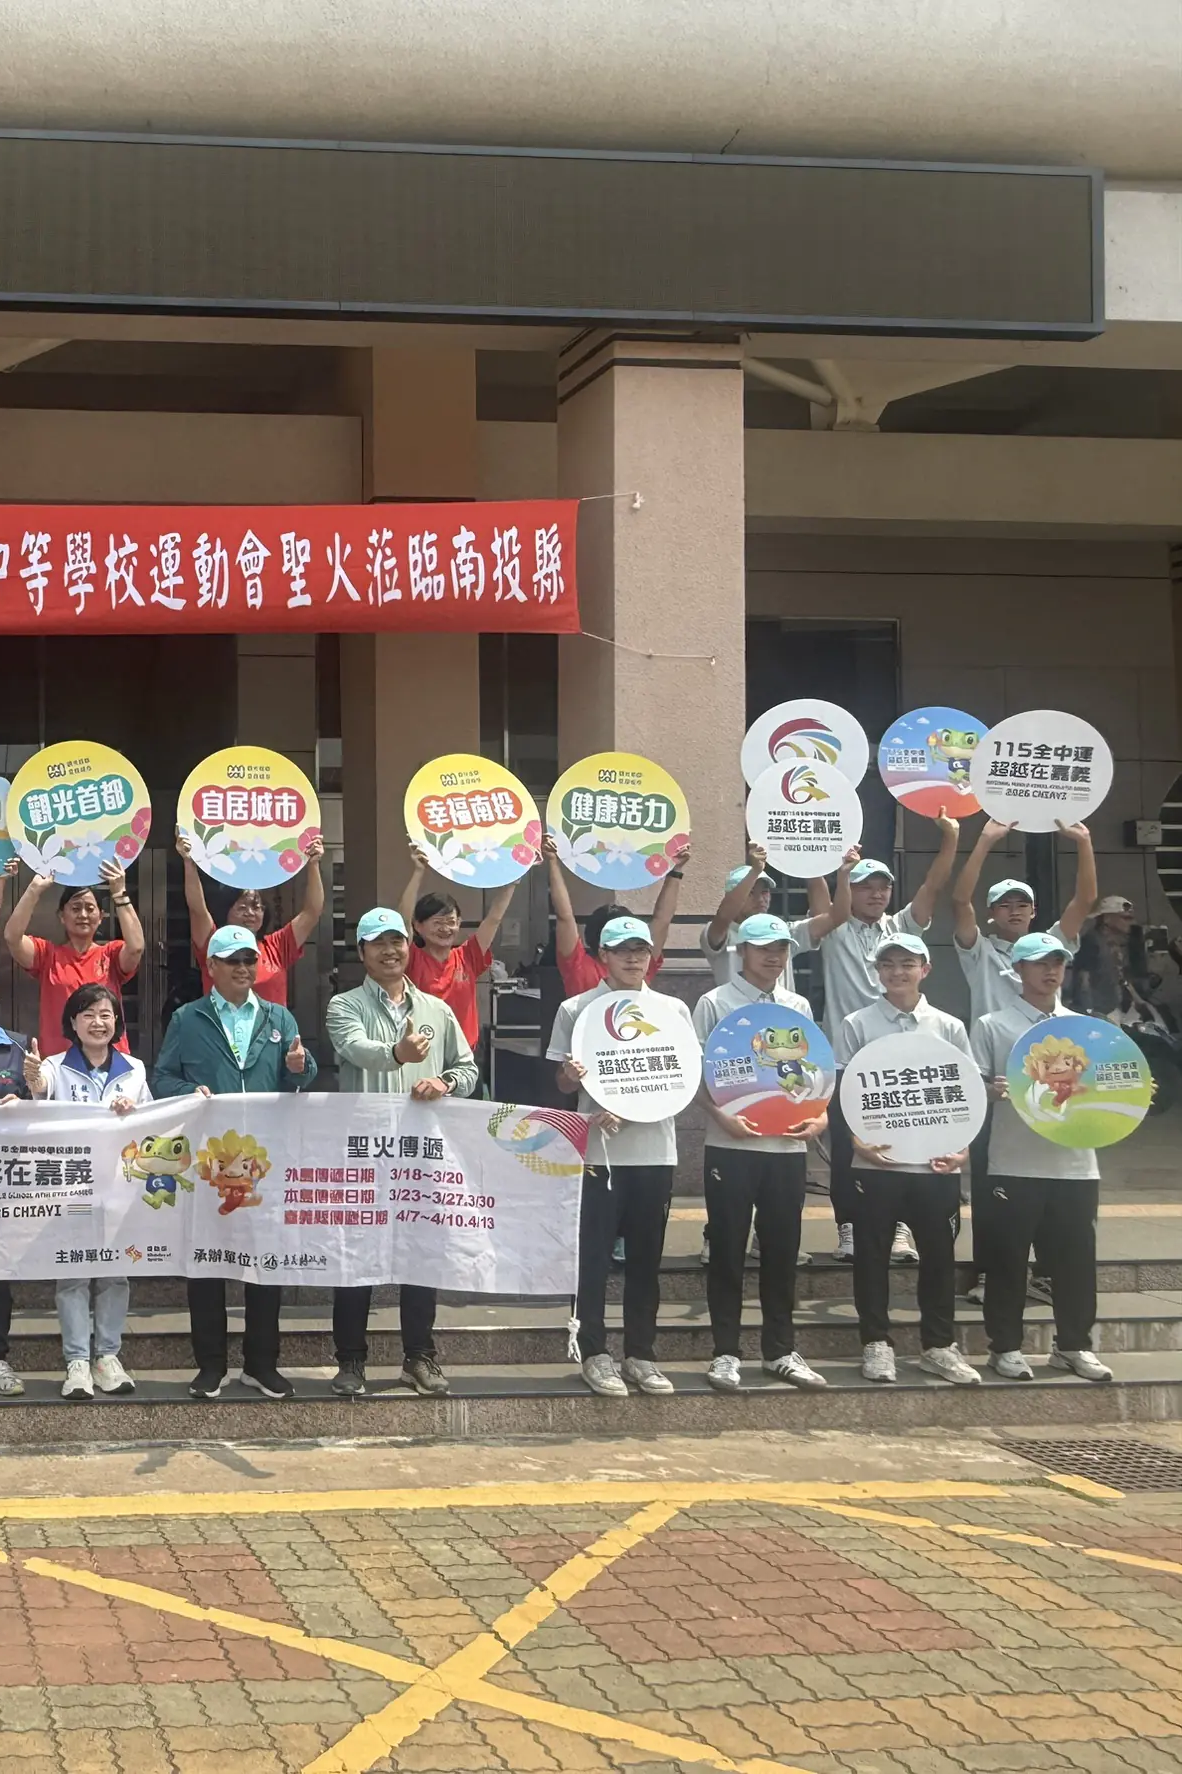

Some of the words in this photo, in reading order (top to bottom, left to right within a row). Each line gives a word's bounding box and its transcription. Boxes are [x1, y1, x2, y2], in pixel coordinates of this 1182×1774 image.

[994, 741, 1094, 763] 115全中運
[26, 778, 125, 827] 觀光首都
[201, 789, 298, 822] 宜居城市
[424, 791, 518, 828] 幸福南投
[570, 791, 668, 829] 健康活力
[857, 1063, 960, 1088] 115全中運
[885, 1119, 911, 1129] 2026
[347, 1135, 444, 1160] 聖火傳遞
[390, 1168, 463, 1184] 3/18~3/20
[13, 1205, 62, 1218] CHIAYI
